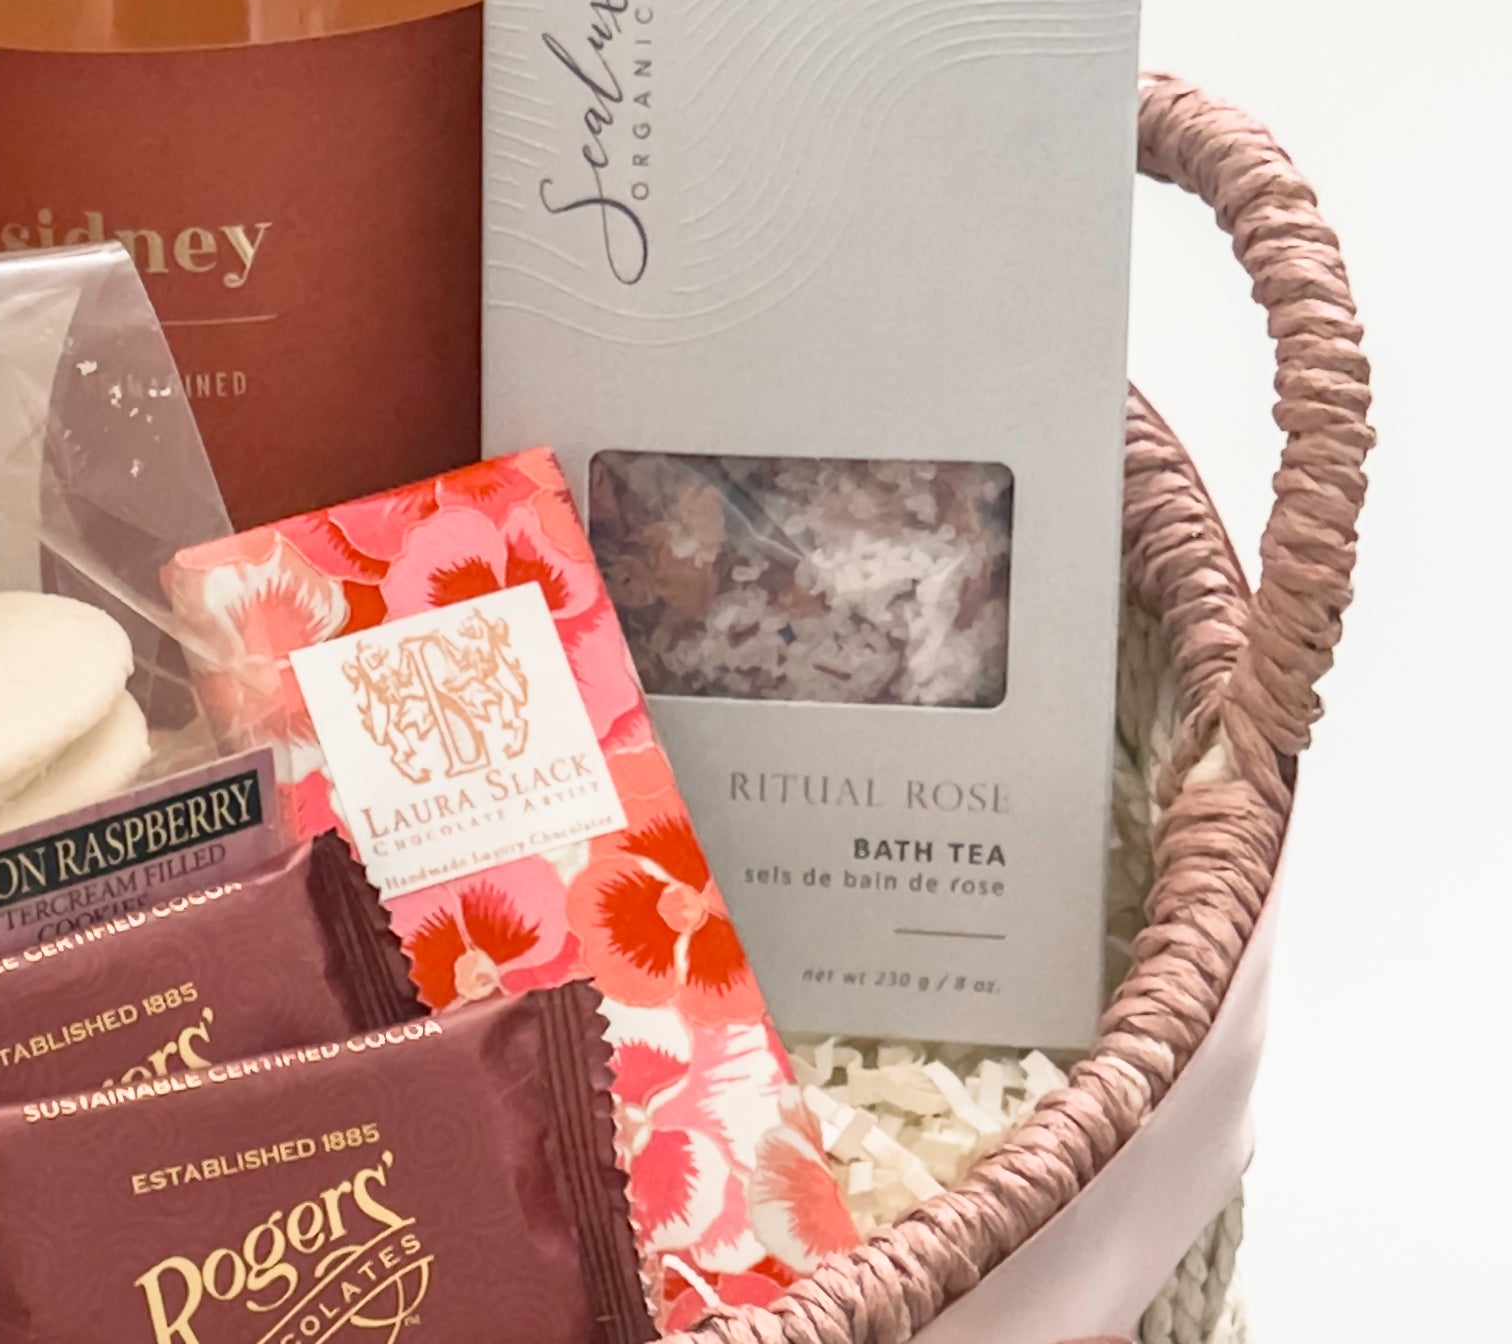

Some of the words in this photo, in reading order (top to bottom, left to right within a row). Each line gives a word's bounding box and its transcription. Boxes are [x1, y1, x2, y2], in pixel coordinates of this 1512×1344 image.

[361, 788, 476, 839] LAURA
[484, 754, 592, 802] SLACK
[728, 771, 886, 807] RITUAL
[906, 779, 1010, 814] ROSE
[54, 778, 254, 881] RASPBERRY
[144, 842, 228, 888] FILLED
[853, 837, 934, 863] BATH
[947, 842, 1007, 867] TEA
[743, 865, 792, 887] sels
[803, 867, 832, 888] de
[843, 869, 898, 891] bain
[909, 872, 939, 893] de
[949, 875, 1006, 897] rose
[141, 981, 199, 1017] 1885
[801, 968, 834, 983] net
[874, 971, 912, 988] 230
[22, 1072, 204, 1123] SUSTAINABLE
[345, 1018, 444, 1053] COCOA
[131, 1137, 317, 1195] ESTABLISHED
[321, 1122, 381, 1153] 1885
